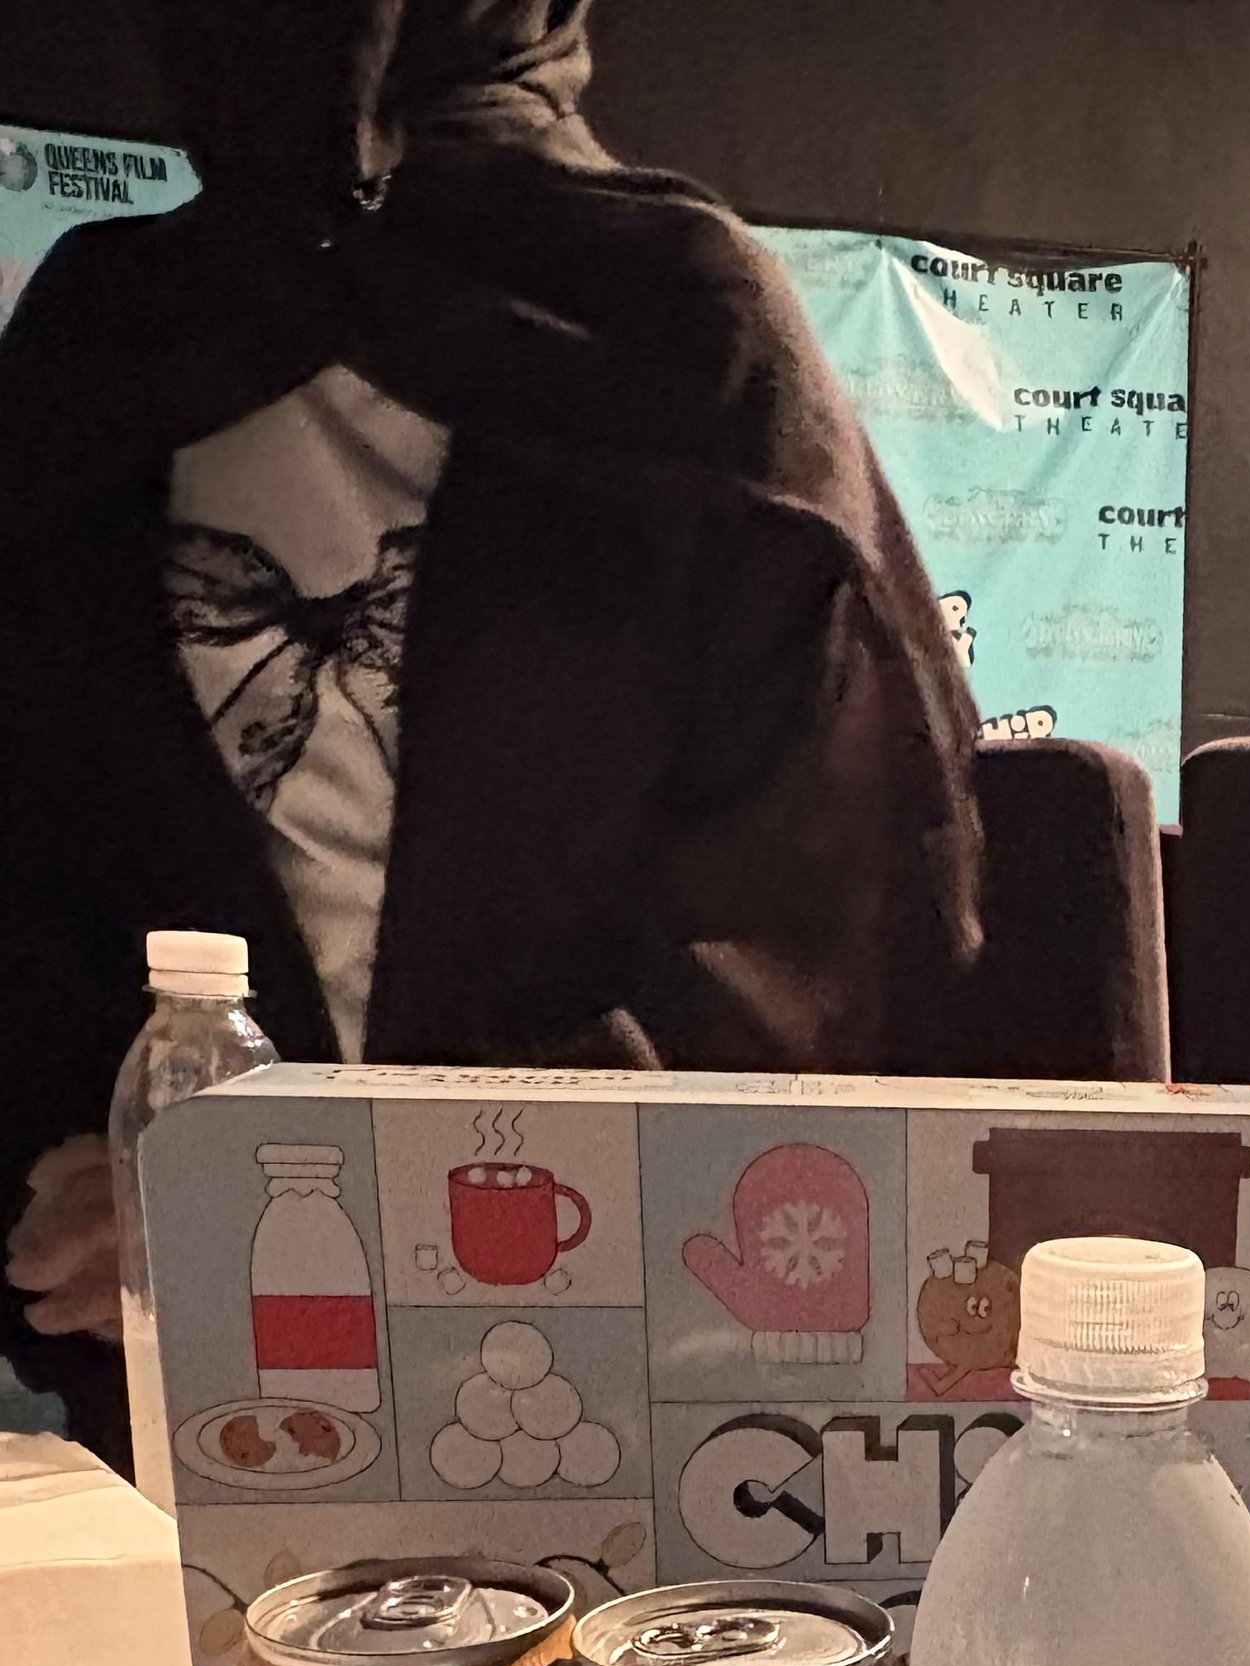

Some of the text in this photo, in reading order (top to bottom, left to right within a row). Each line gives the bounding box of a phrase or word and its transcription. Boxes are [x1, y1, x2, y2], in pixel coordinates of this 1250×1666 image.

[44, 142, 168, 182] QUEENS FILM
[48, 170, 135, 205] FESTIVAL
[910, 253, 1124, 297] court square
[914, 285, 1123, 322] HEATER
[1013, 385, 1101, 411] court
[1015, 413, 1188, 440] THEATE
[1098, 503, 1187, 529] court
[1098, 531, 1178, 556] THE
